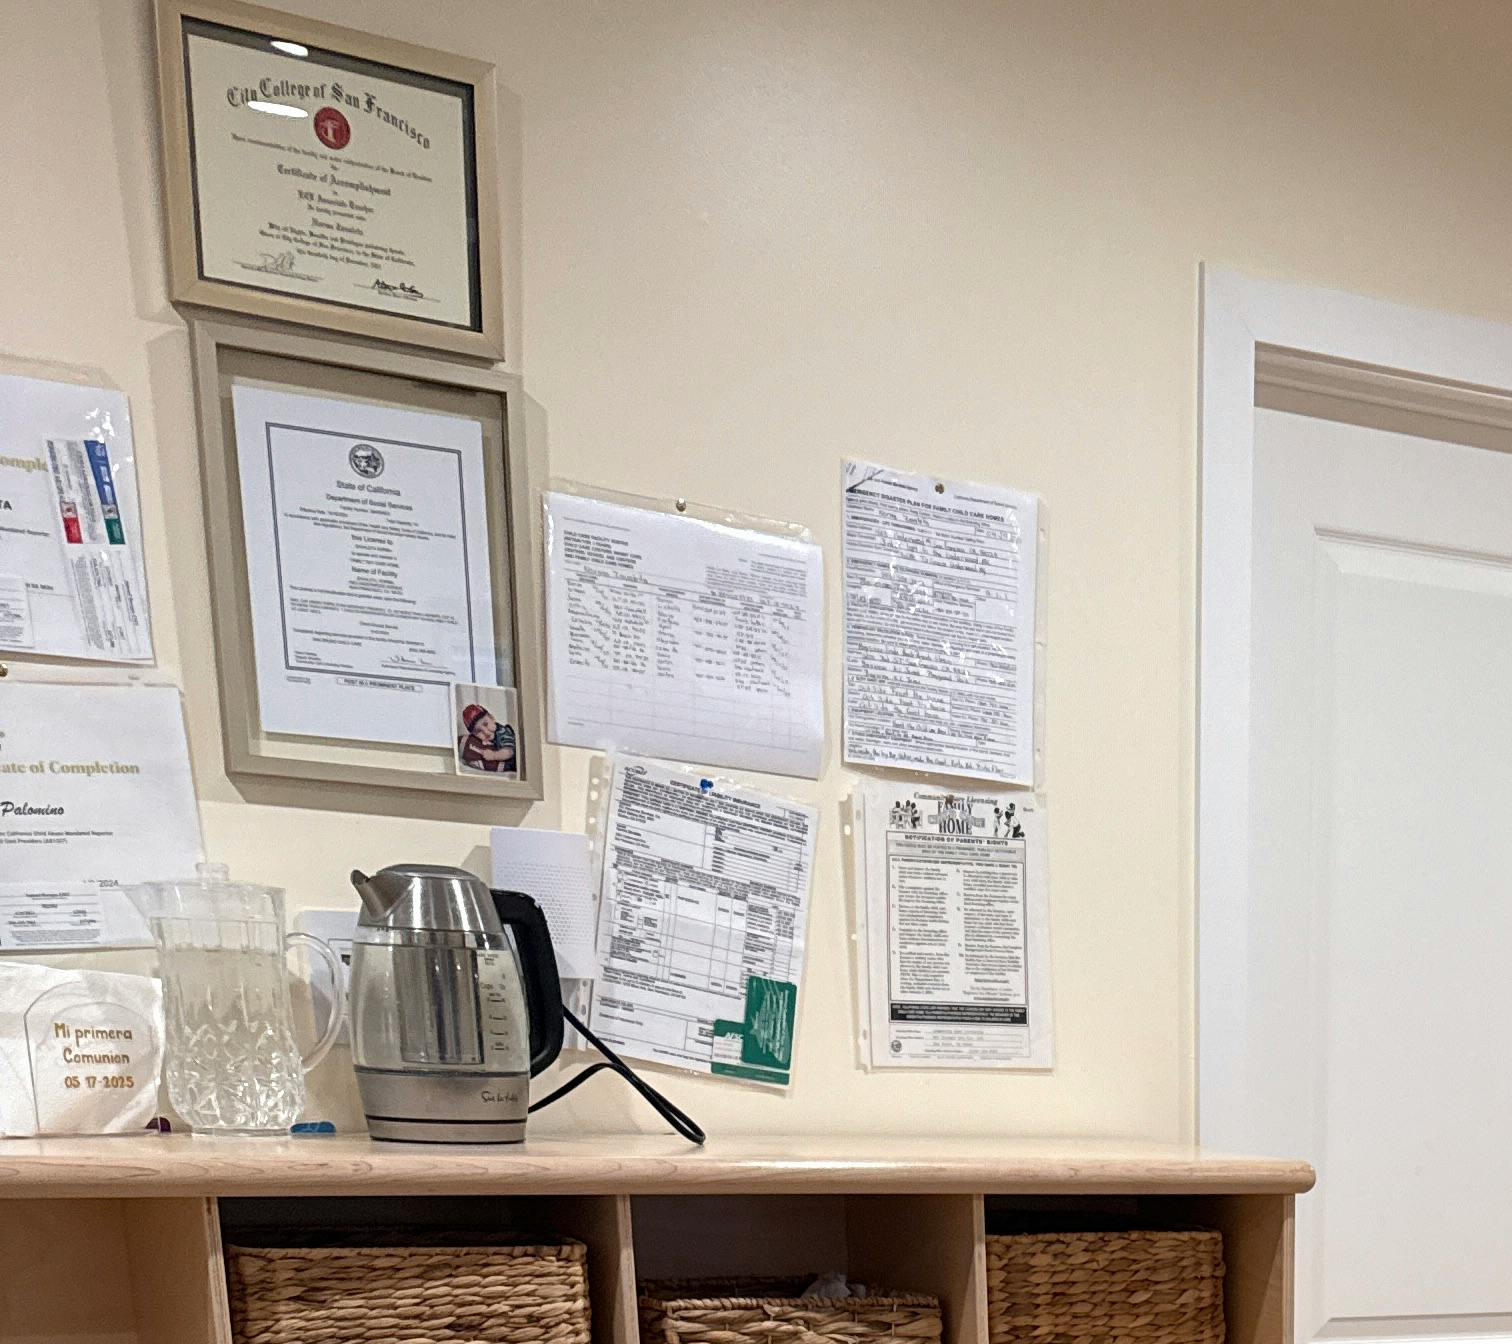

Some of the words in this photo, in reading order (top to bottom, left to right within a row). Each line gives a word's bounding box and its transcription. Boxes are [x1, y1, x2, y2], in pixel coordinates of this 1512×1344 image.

[227, 86, 257, 107] City
[259, 77, 310, 99] College
[313, 83, 327, 99] of
[331, 82, 360, 110] San
[364, 92, 431, 149] Francisco
[336, 480, 356, 491] State
[357, 483, 365, 492] of
[366, 484, 401, 496] California
[325, 493, 360, 504] Department
[351, 566, 371, 574] Name
[29, 760, 45, 775] of
[49, 760, 140, 777] Completion
[1, 801, 65, 817] Palomino
[939, 818, 973, 835] HOME
[54, 1022, 71, 1039] Mi
[75, 1026, 133, 1048] primera
[63, 1047, 130, 1064] Comunion
